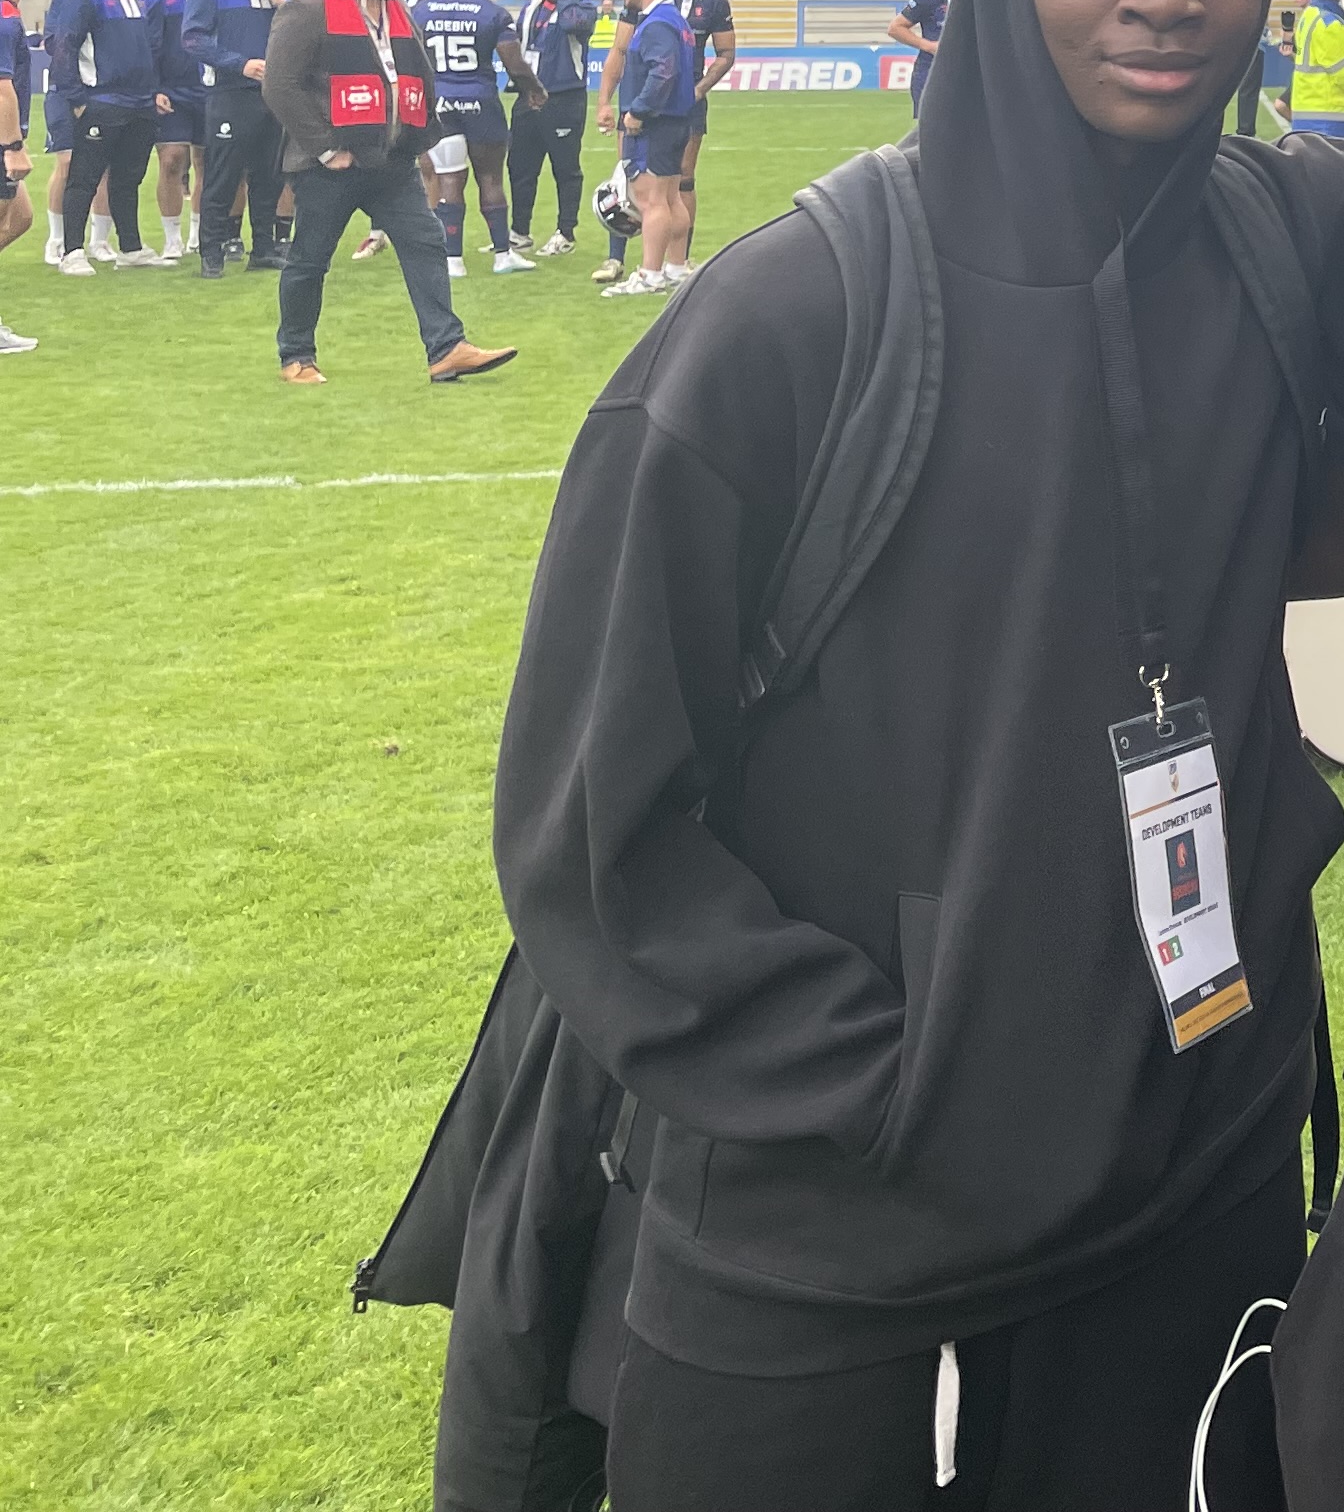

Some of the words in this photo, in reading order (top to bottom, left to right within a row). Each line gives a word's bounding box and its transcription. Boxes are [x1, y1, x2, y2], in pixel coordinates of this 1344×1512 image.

[426, 35, 479, 73] 15
[703, 62, 863, 91] ETFRED
[1141, 812, 1190, 841] DEVELOPMENT
[1190, 803, 1213, 825] TEAMS
[1162, 948, 1171, 965] 1
[1172, 941, 1181, 958] 2
